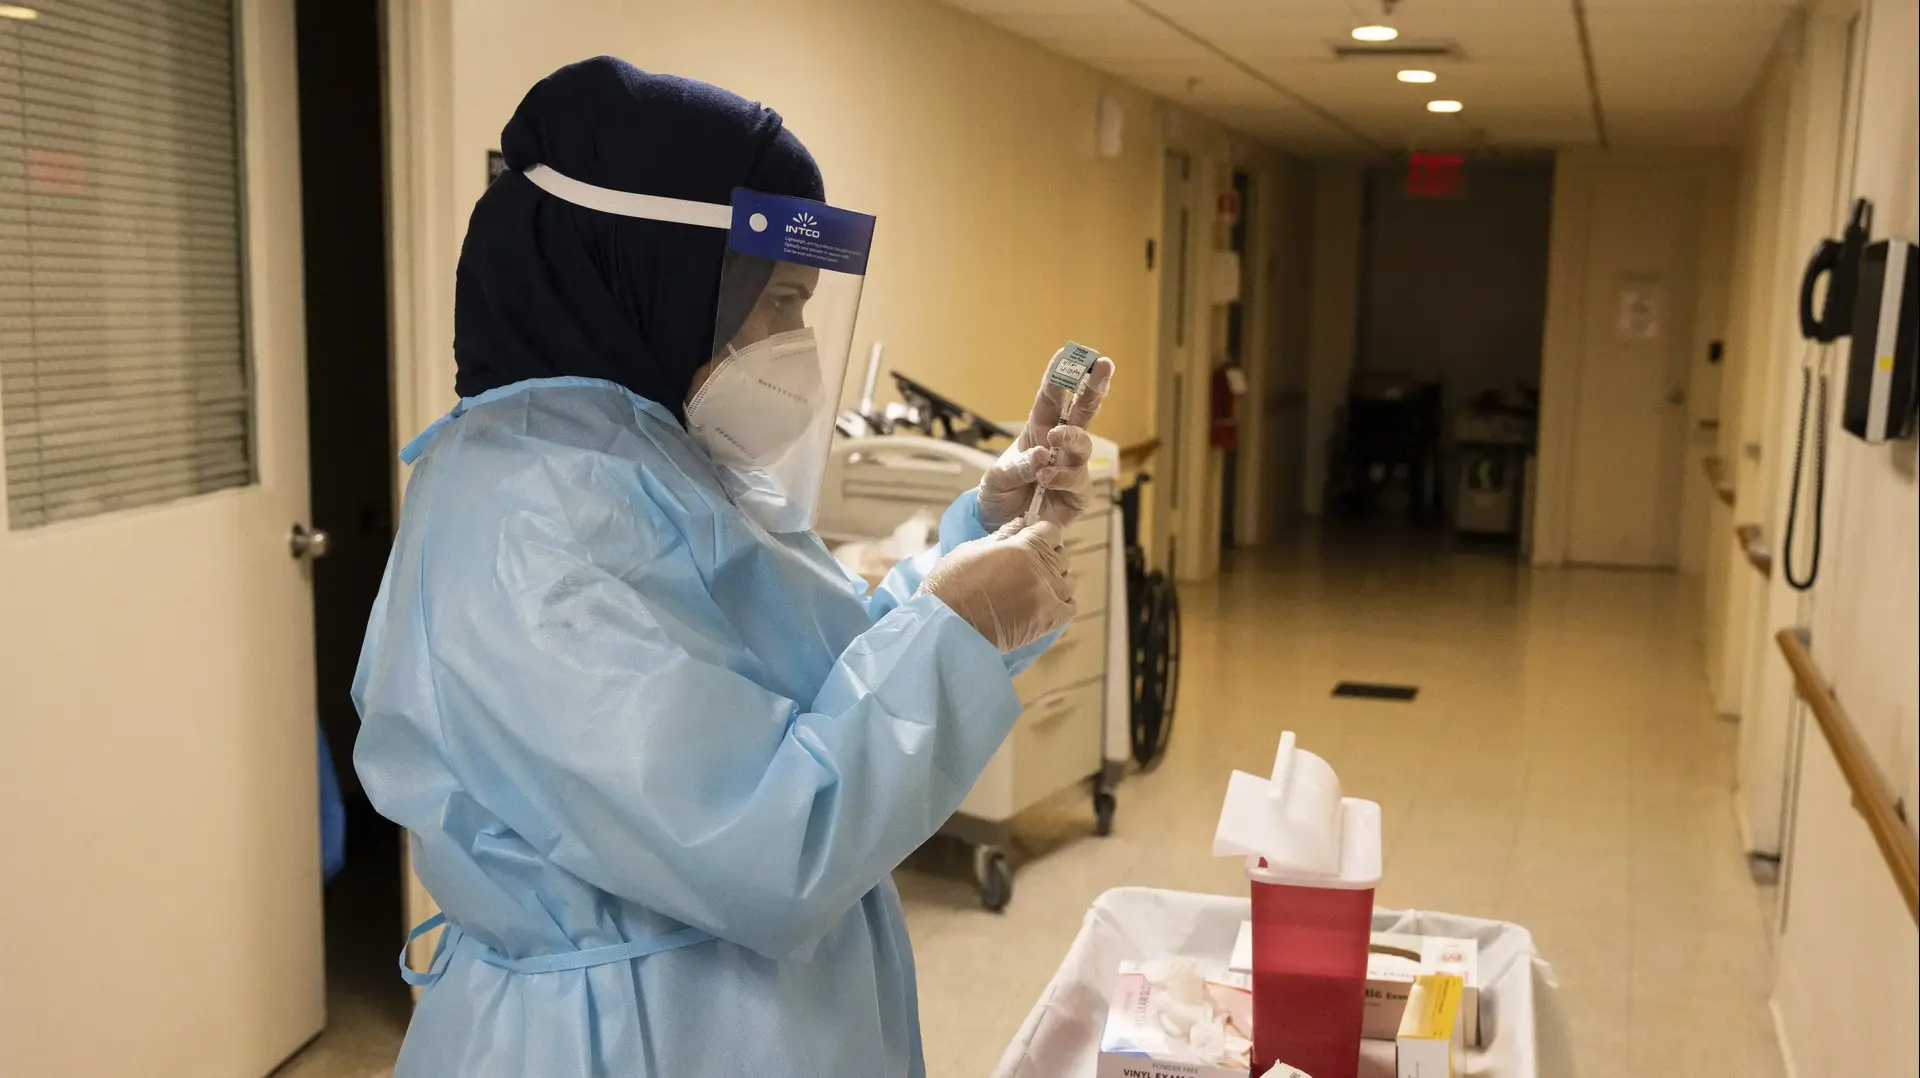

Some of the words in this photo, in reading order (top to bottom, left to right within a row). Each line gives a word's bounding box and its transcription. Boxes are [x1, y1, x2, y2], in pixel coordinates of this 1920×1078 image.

[785, 225, 820, 238] INTCO
[1152, 1063, 1180, 1071] POWDER
[1123, 1068, 1151, 1078] VINYL
